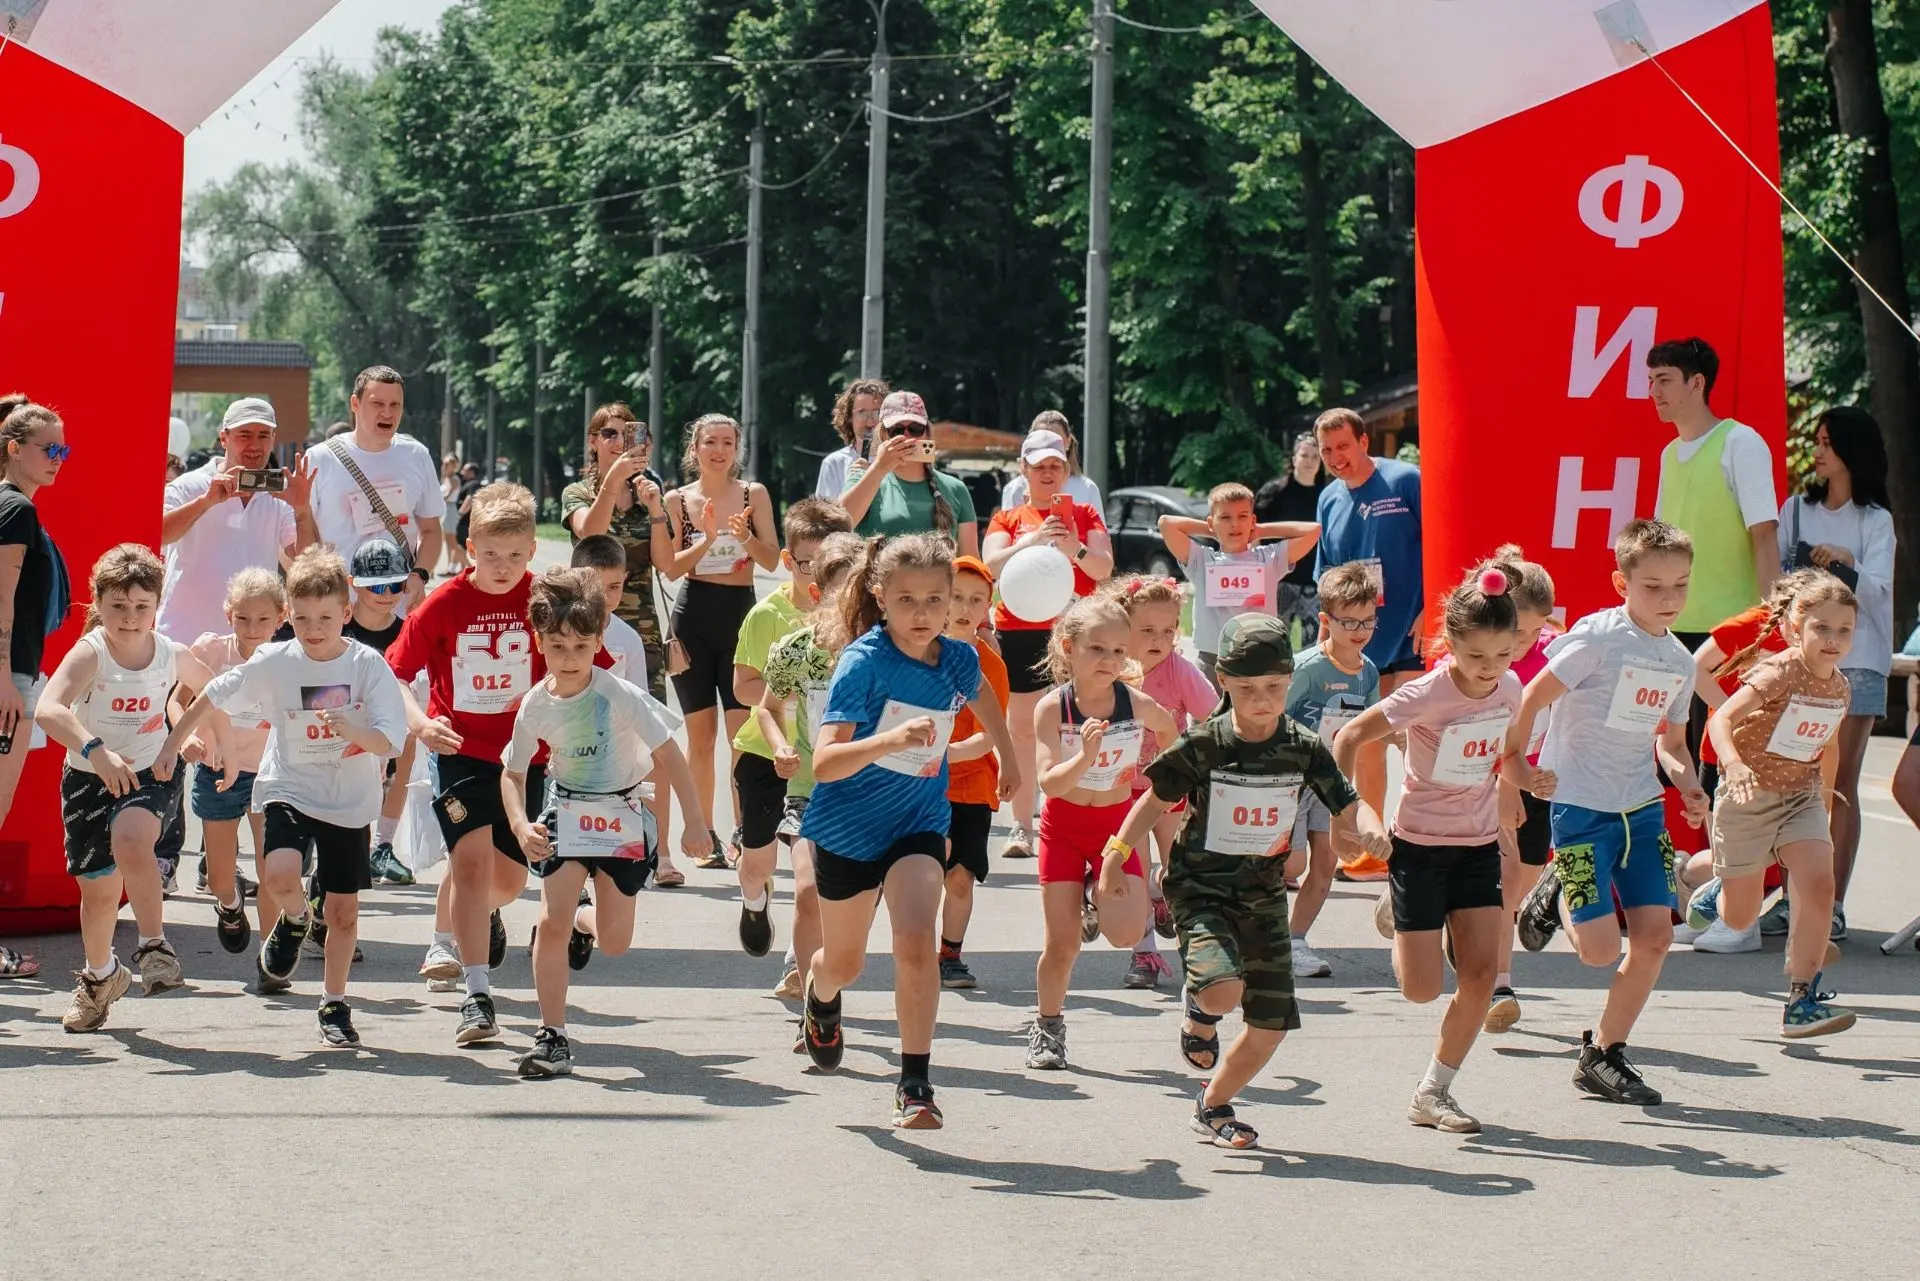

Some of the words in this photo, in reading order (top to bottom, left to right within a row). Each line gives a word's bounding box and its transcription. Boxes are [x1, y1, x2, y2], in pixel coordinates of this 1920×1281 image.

[1220, 576, 1250, 589] 049
[477, 612, 517, 621] BASKETBALL
[466, 624, 484, 632] BORN
[487, 623, 496, 631] TO
[498, 623, 507, 631] BE
[509, 621, 524, 630] MVP
[472, 674, 512, 690] 012
[111, 696, 151, 713] 020
[306, 724, 340, 739] 01
[1796, 721, 1829, 738] 022
[1463, 737, 1501, 758] 014
[1090, 749, 1123, 767] 17
[579, 815, 622, 832] 004
[1232, 806, 1279, 827] 015
